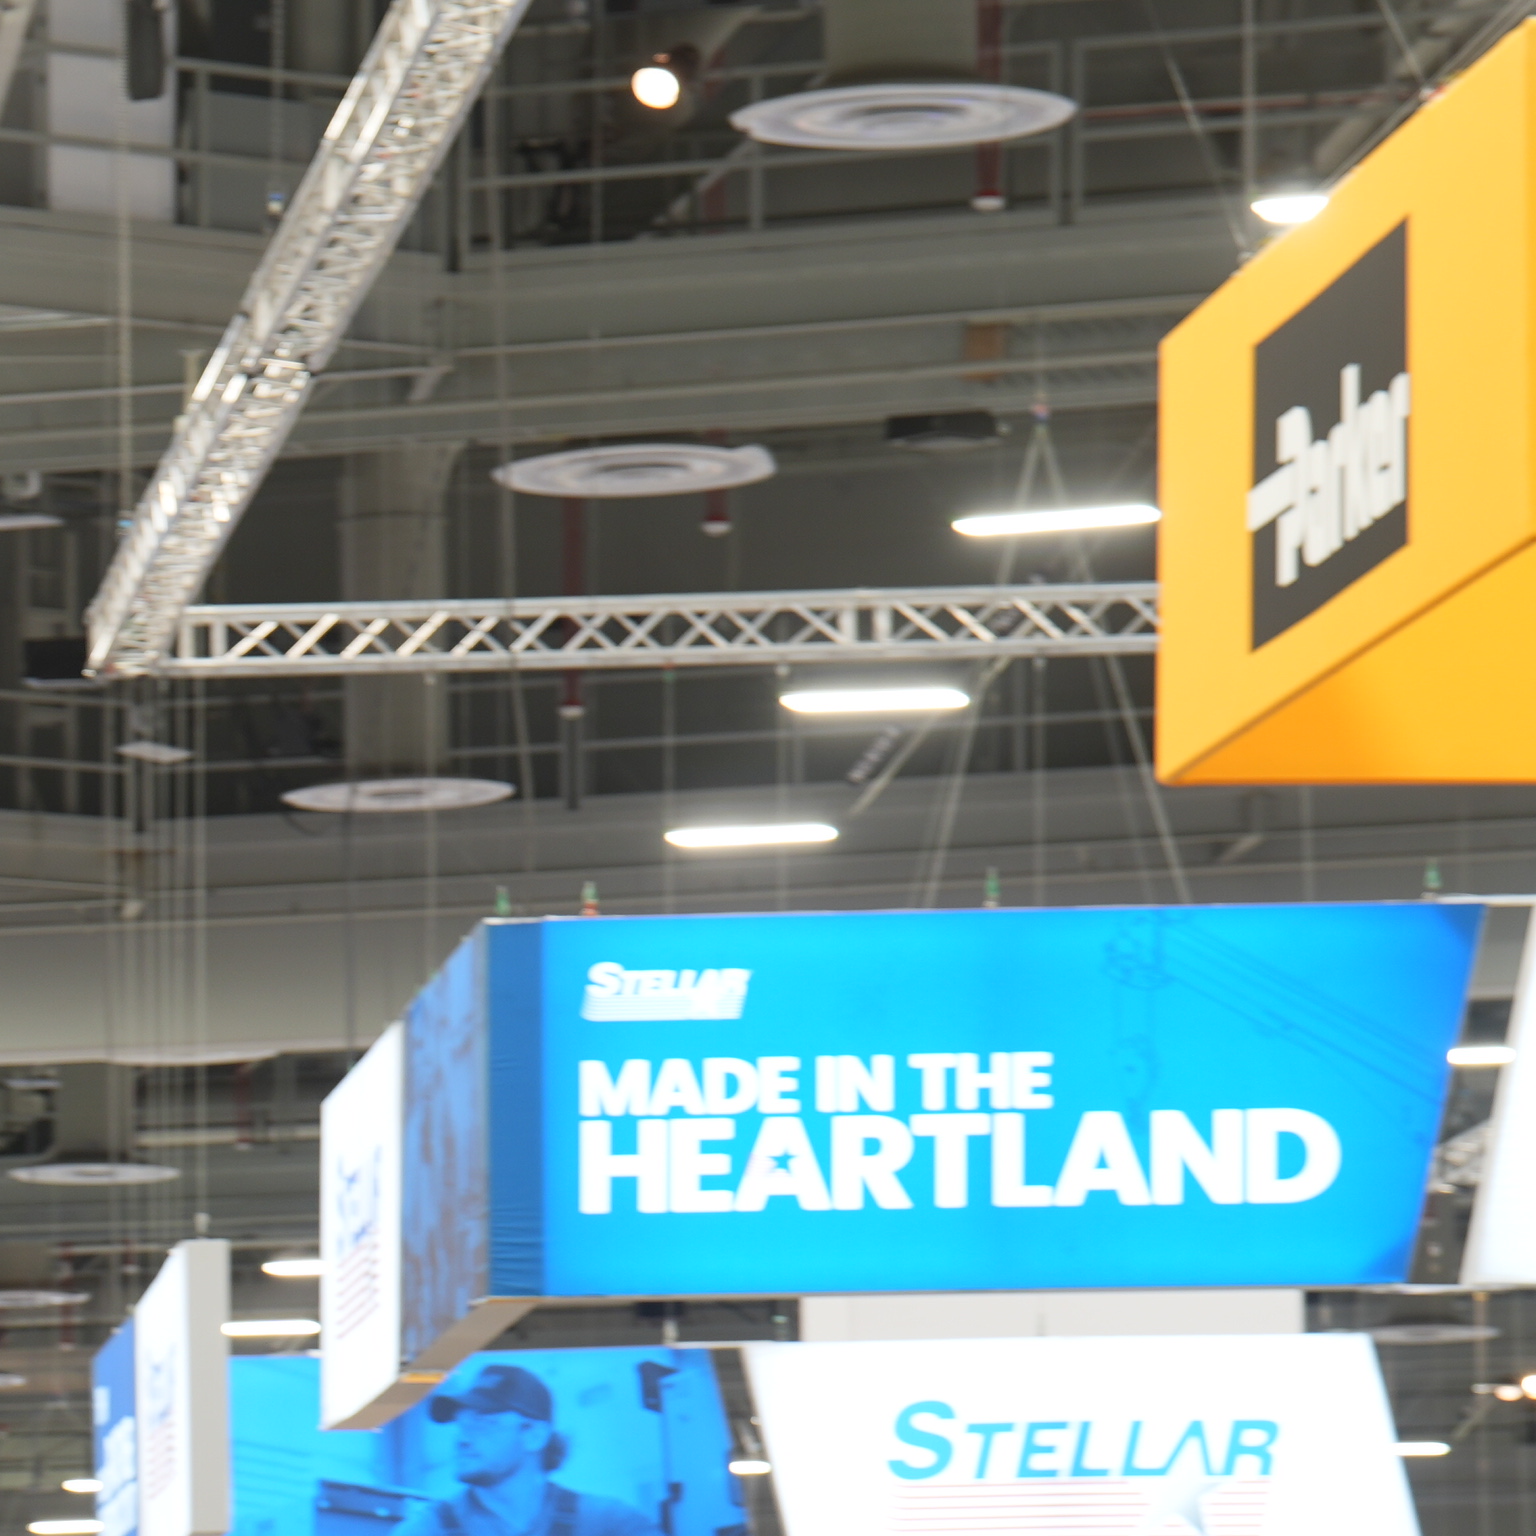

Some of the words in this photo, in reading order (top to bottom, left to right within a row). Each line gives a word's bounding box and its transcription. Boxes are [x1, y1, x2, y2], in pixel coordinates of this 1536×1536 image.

[1247, 364, 1411, 587] Parker
[579, 1056, 801, 1116] MADE
[815, 1054, 895, 1112] IN
[908, 1051, 1054, 1110] THE
[579, 1107, 1342, 1214] HEARTLAND
[887, 1400, 1280, 1480] STELLAR
